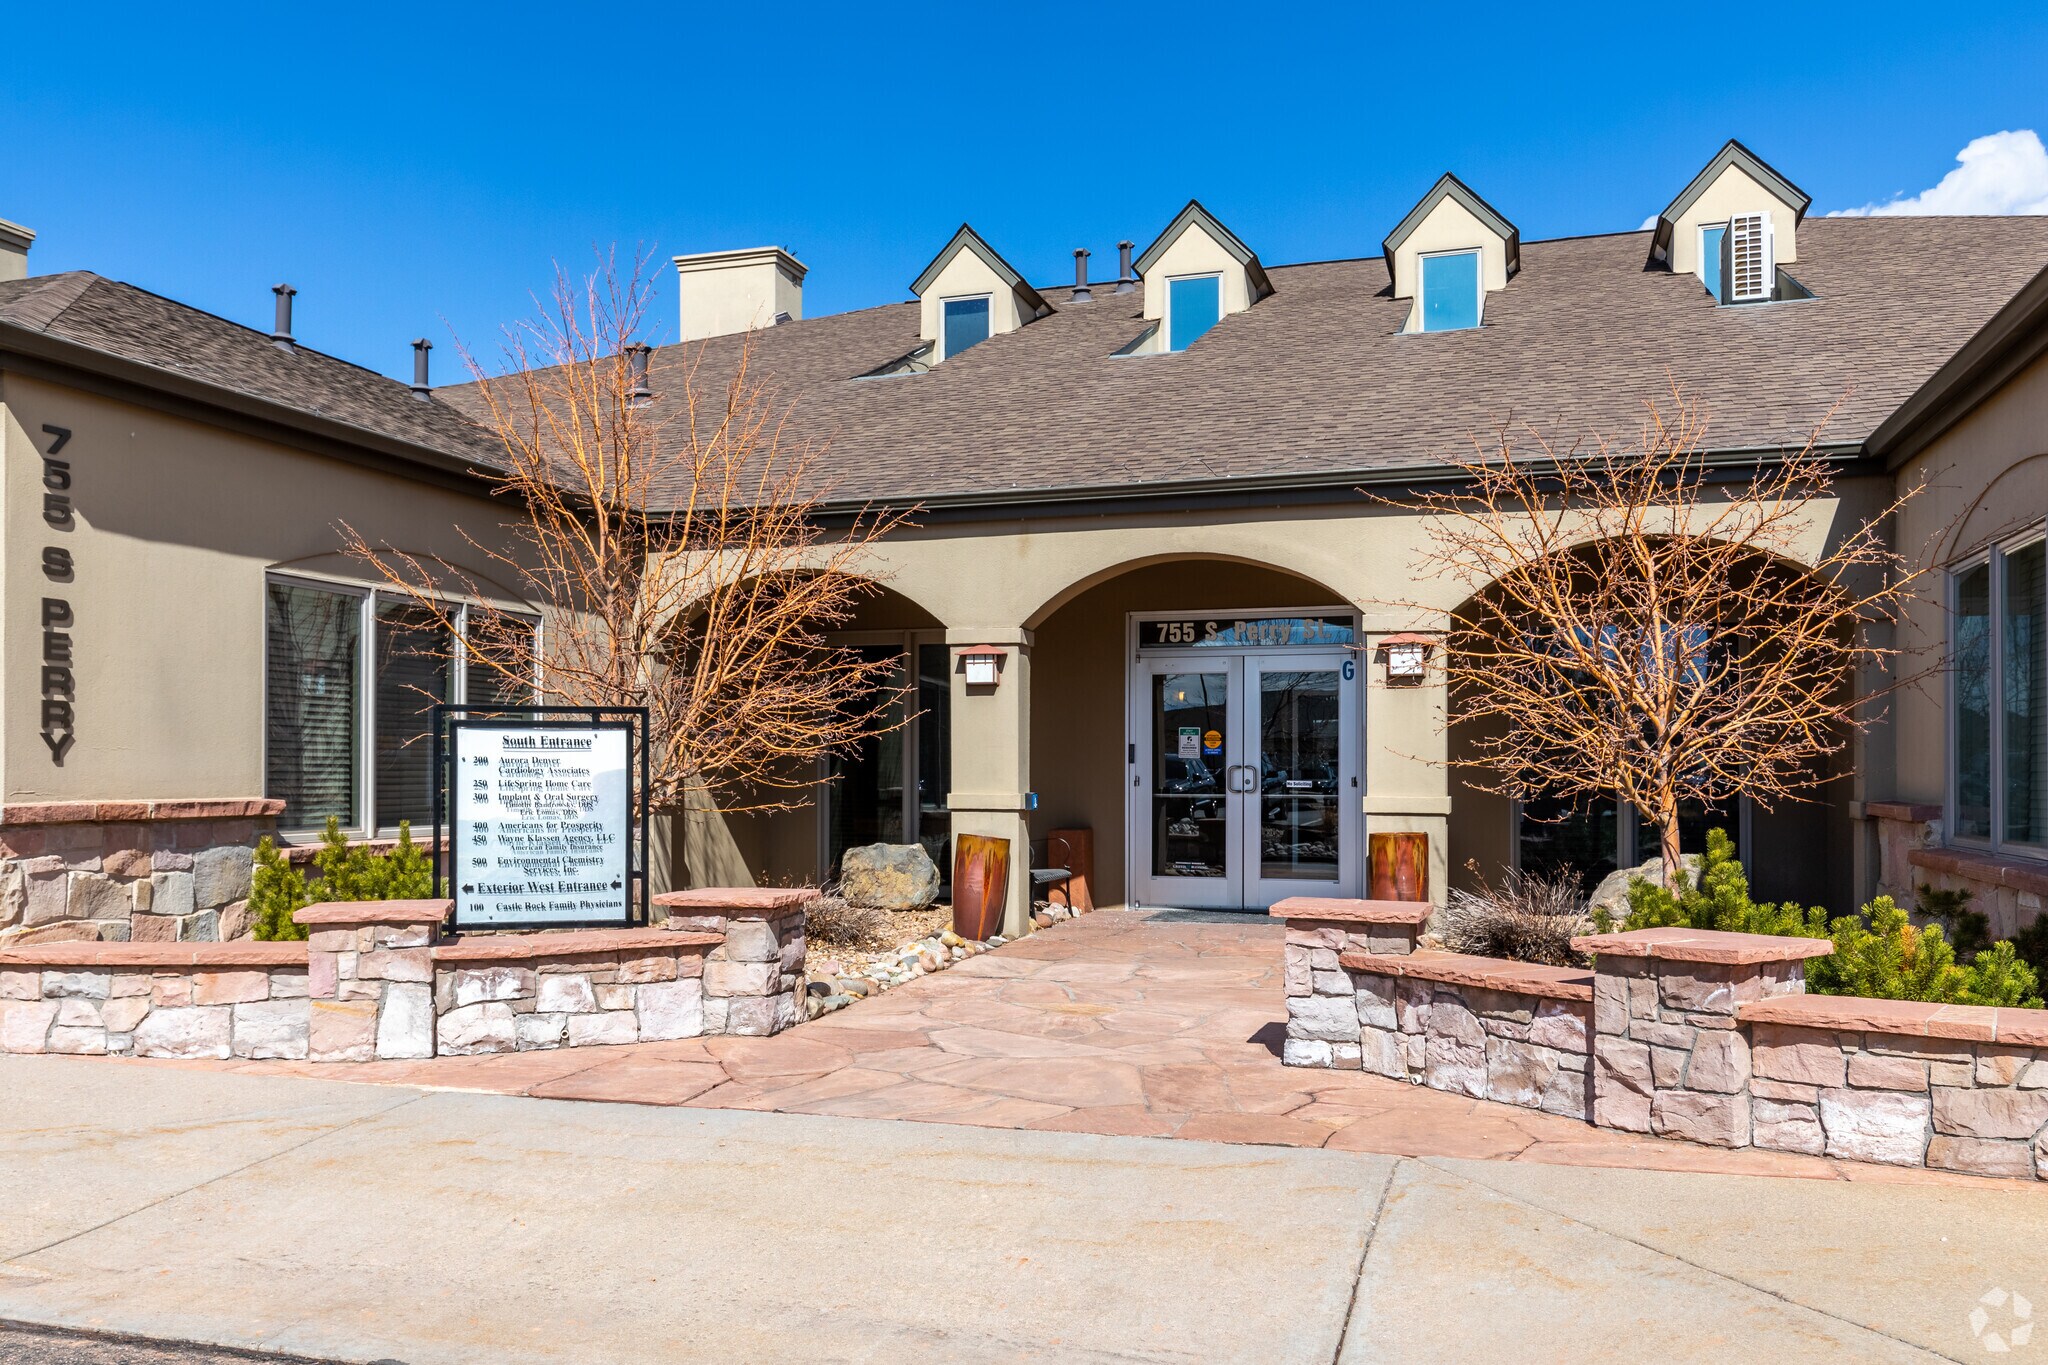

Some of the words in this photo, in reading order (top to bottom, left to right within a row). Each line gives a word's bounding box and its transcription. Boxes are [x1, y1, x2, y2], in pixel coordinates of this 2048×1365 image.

[42, 424, 72, 525] 755
[42, 546, 73, 578] S
[1157, 622, 1195, 643] 755
[1205, 621, 1224, 641] S.
[1234, 621, 1290, 643] Perry
[1302, 618, 1331, 639] St.
[1342, 661, 1354, 681] G
[40, 597, 74, 763] PERRY
[502, 735, 536, 747] South
[541, 735, 592, 748] Entrance
[473, 756, 488, 764] 200
[498, 756, 529, 764] Aurora
[532, 756, 560, 764] Denver
[498, 766, 544, 775] Cardiology
[548, 766, 590, 774] Associates
[473, 780, 488, 788] 250
[498, 780, 543, 790] LifeSpring
[545, 780, 569, 788] Home
[571, 780, 592, 788] Care
[498, 793, 531, 801] Implant
[566, 793, 599, 803] Surgery
[561, 822, 603, 831] Prosperity
[497, 835, 524, 843] Wayne
[562, 835, 593, 843] Agency,
[597, 834, 616, 842] LLC
[472, 857, 487, 865] 500
[562, 856, 604, 866] Chemistry
[477, 882, 525, 894] Exterior
[527, 881, 554, 893] West
[558, 881, 608, 892] Entrance
[469, 904, 484, 912] 100
[496, 903, 522, 912] Castle
[525, 902, 546, 911] Rock
[549, 901, 577, 911] Family
[580, 900, 622, 910] Physicians
